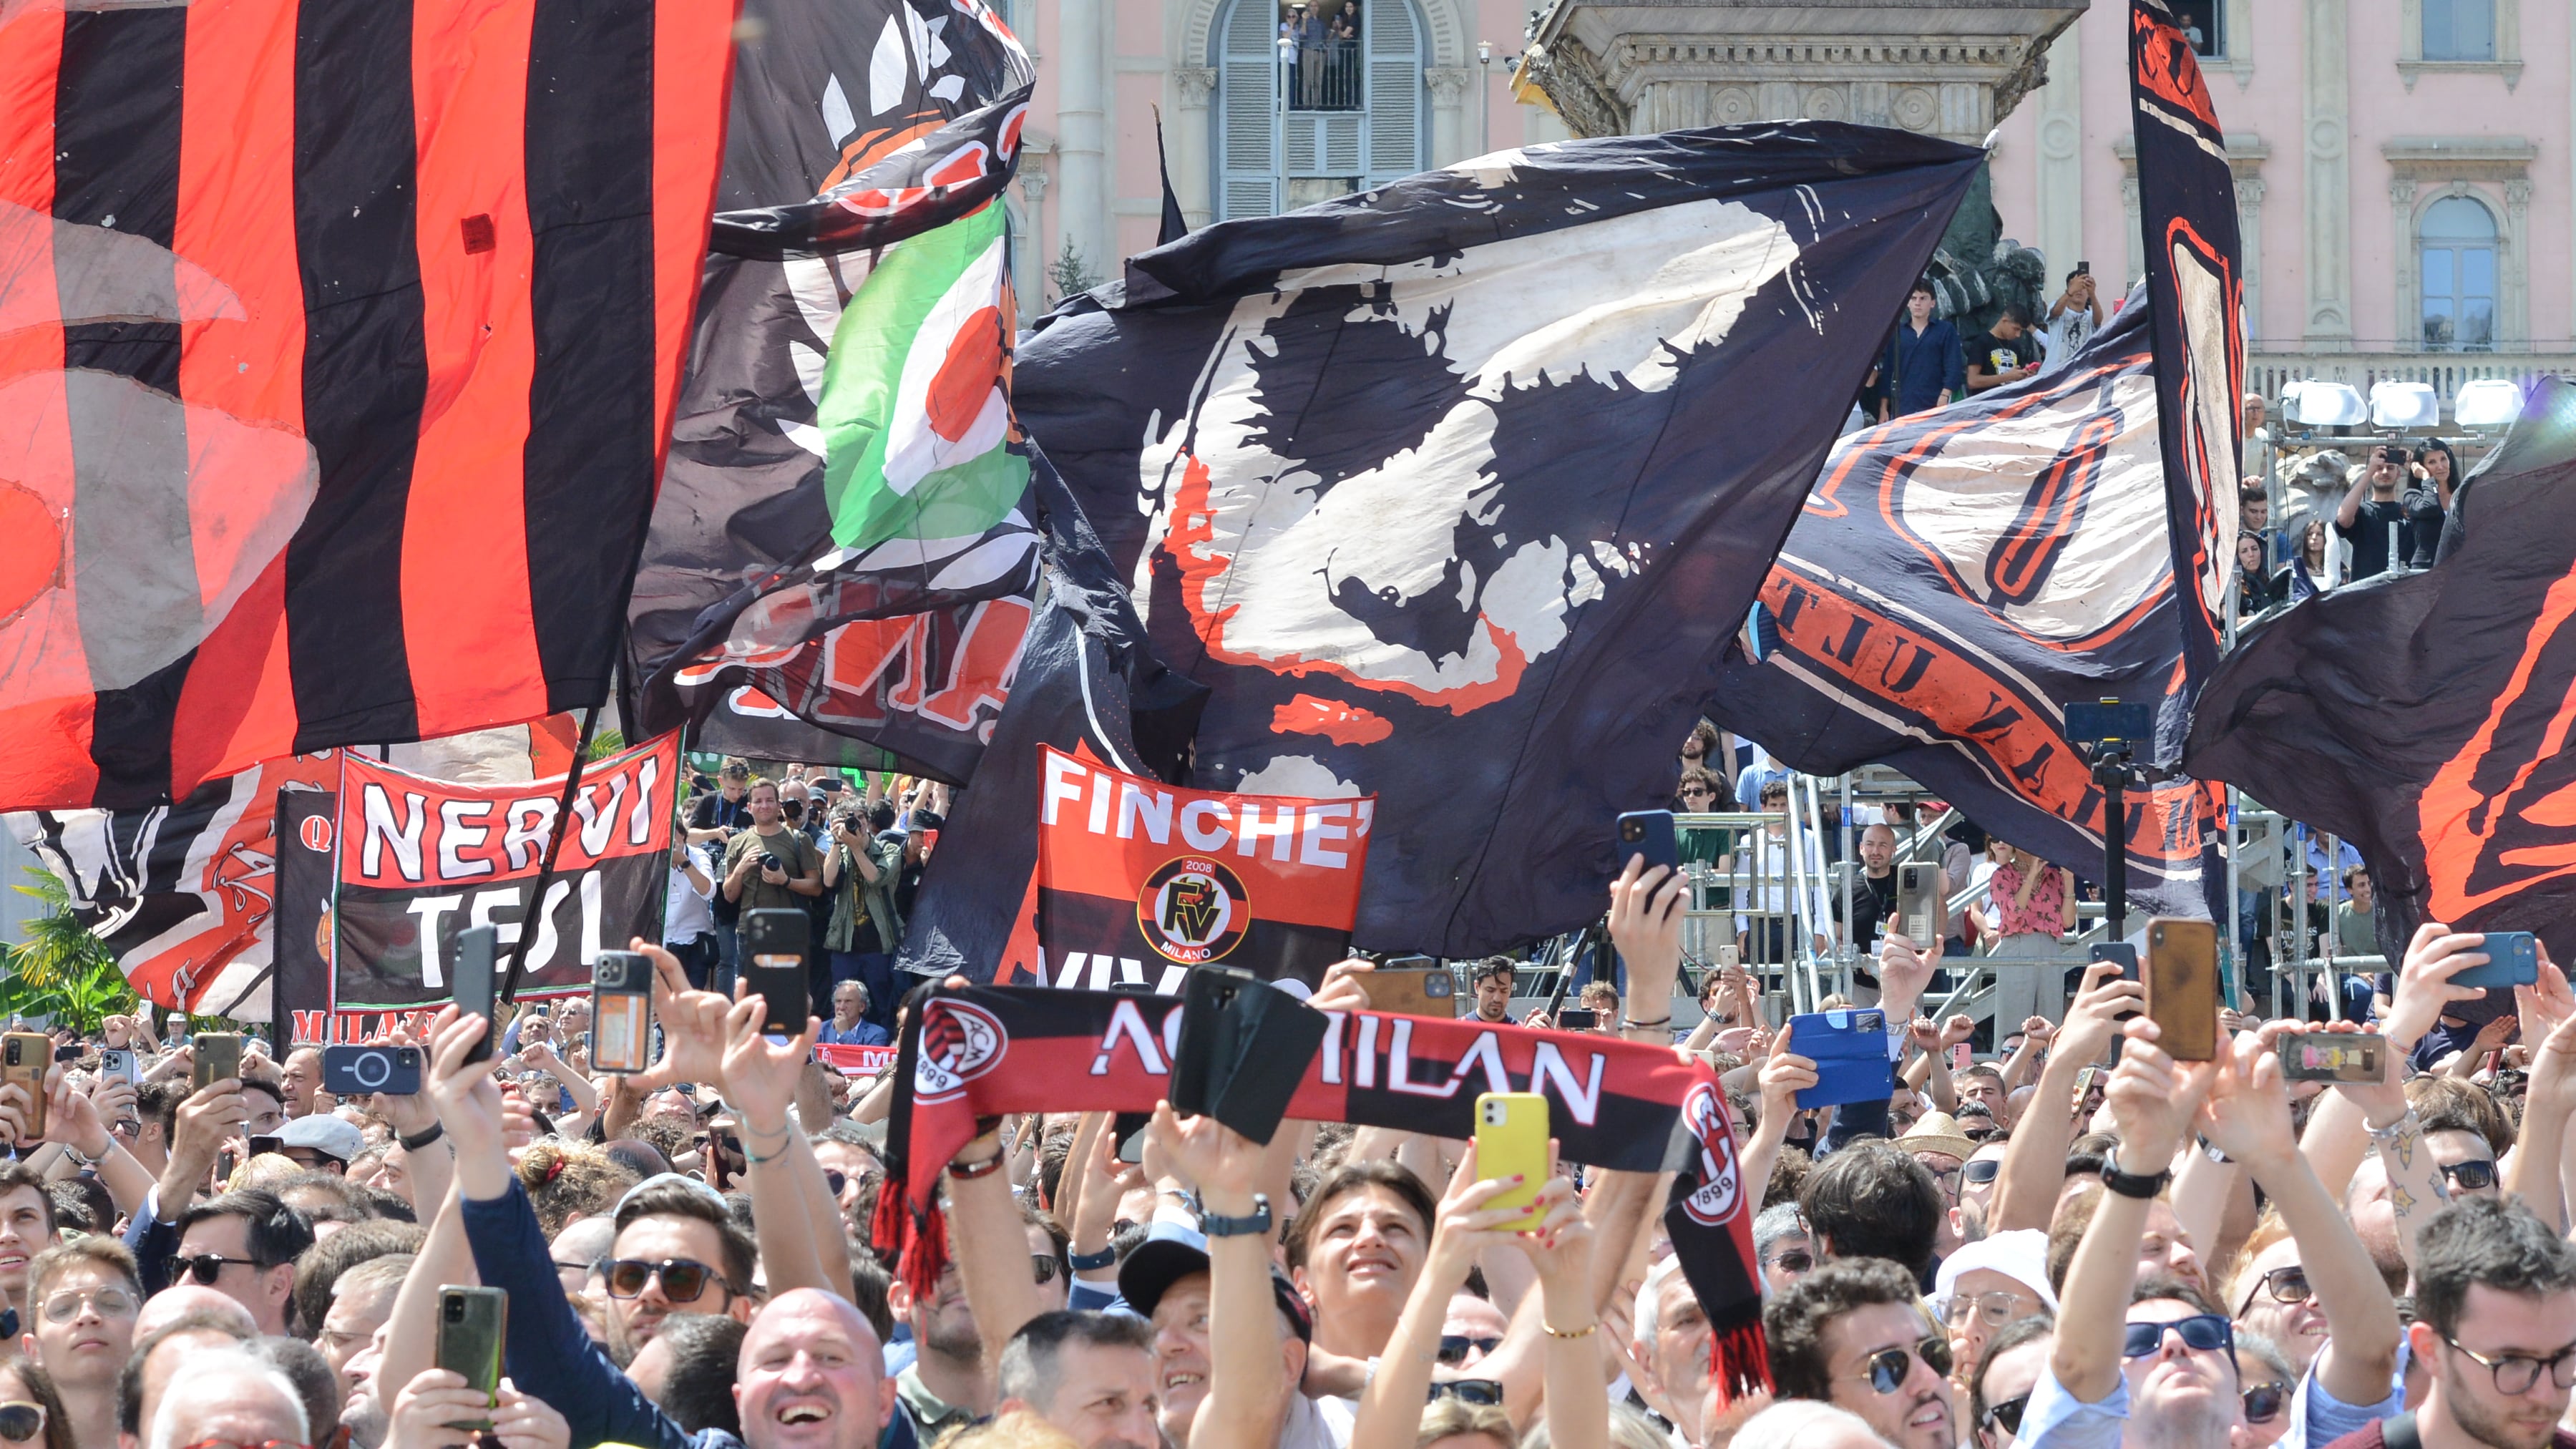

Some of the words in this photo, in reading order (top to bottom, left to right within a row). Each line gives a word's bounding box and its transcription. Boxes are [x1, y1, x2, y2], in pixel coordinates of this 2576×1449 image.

[361, 756, 658, 882] NERVI
[1186, 860, 1212, 873] 2008
[406, 869, 601, 988] TESI
[1161, 940, 1211, 960] MILANO
[961, 1016, 990, 1063] ACM
[1695, 1176, 1734, 1207] 1899
